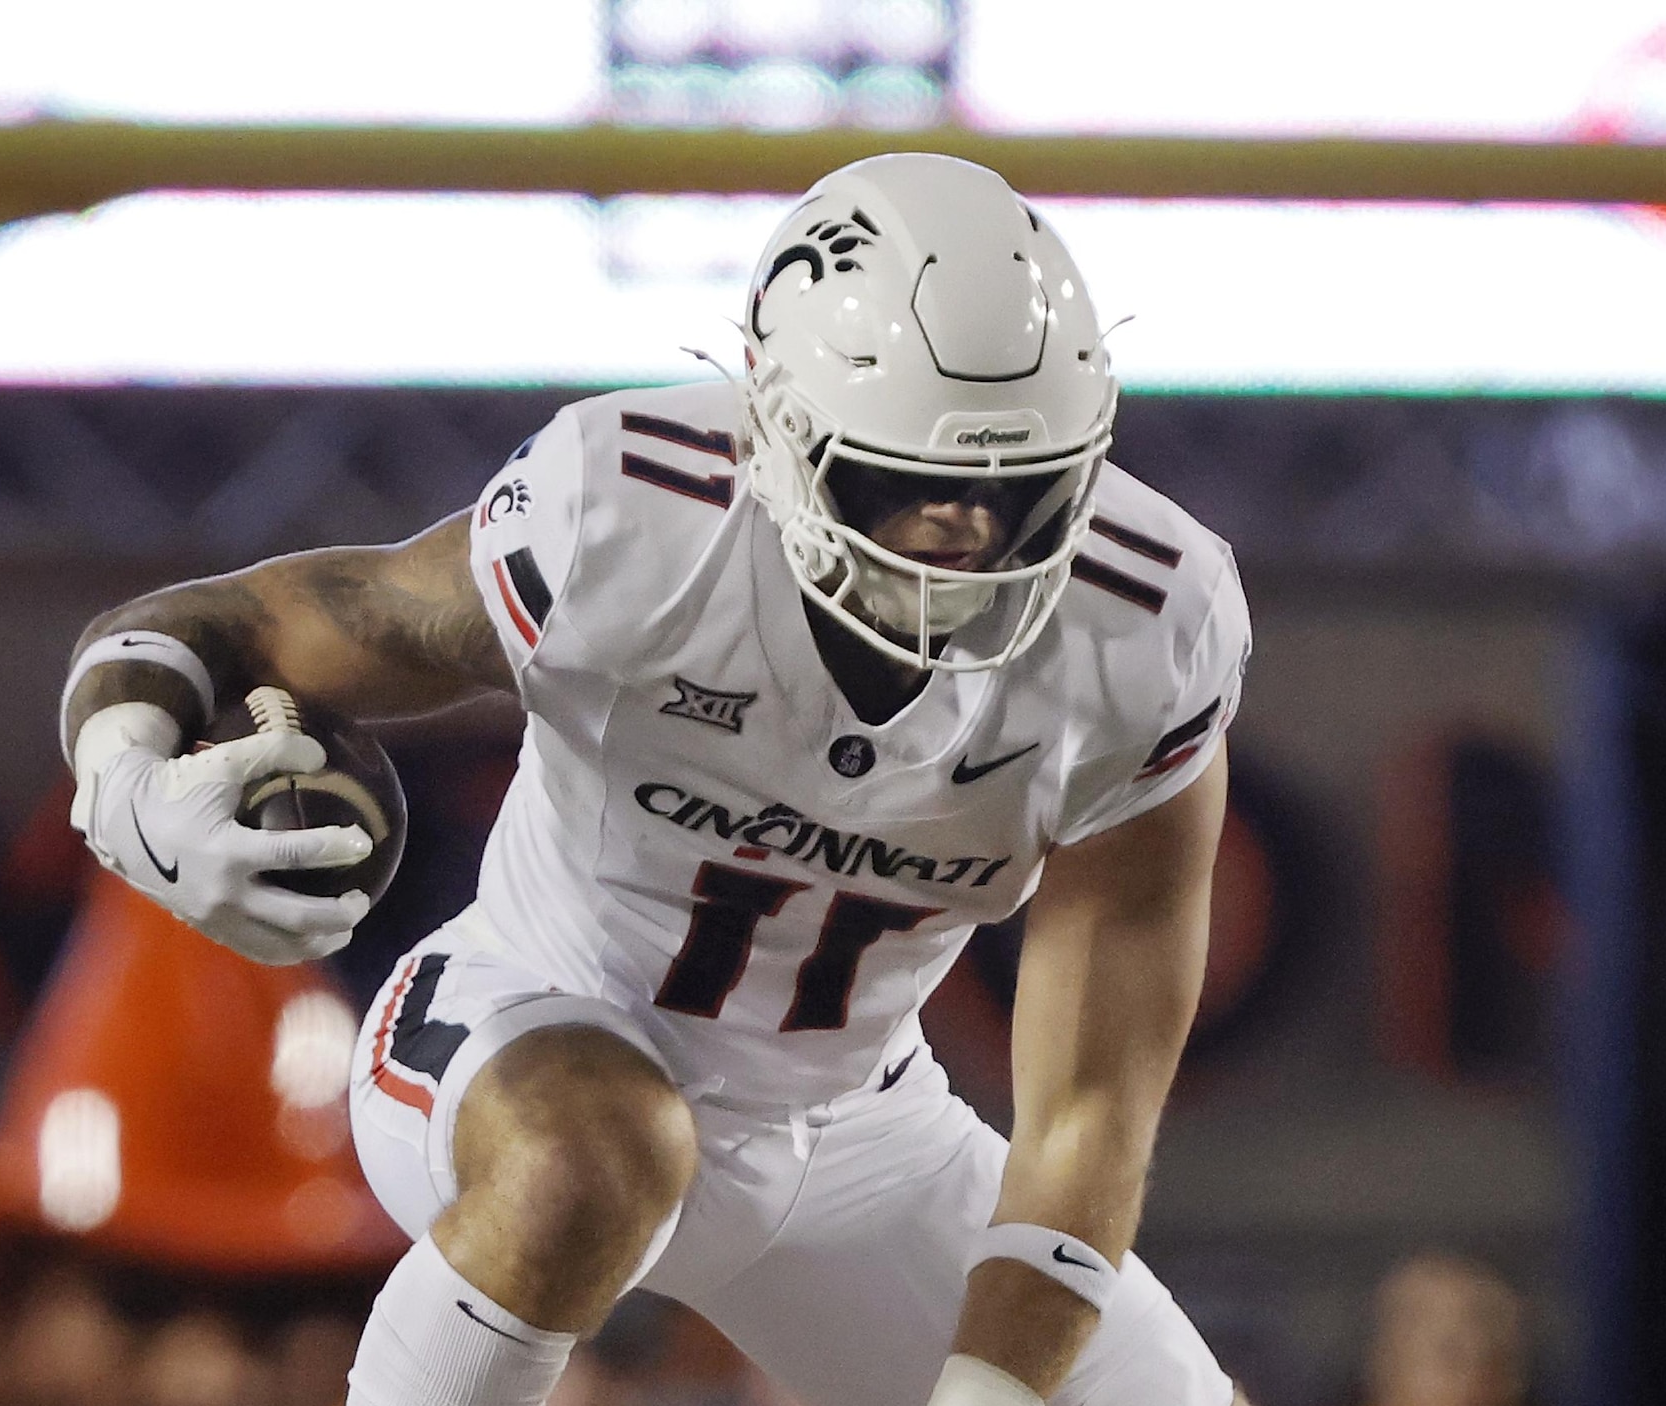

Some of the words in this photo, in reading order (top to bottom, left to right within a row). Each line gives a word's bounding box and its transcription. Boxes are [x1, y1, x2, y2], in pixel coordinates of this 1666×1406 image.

[622, 409, 736, 510] 11
[1070, 514, 1184, 617] 11
[634, 782, 1013, 887] CINCINNATI
[653, 860, 949, 1033] 11
